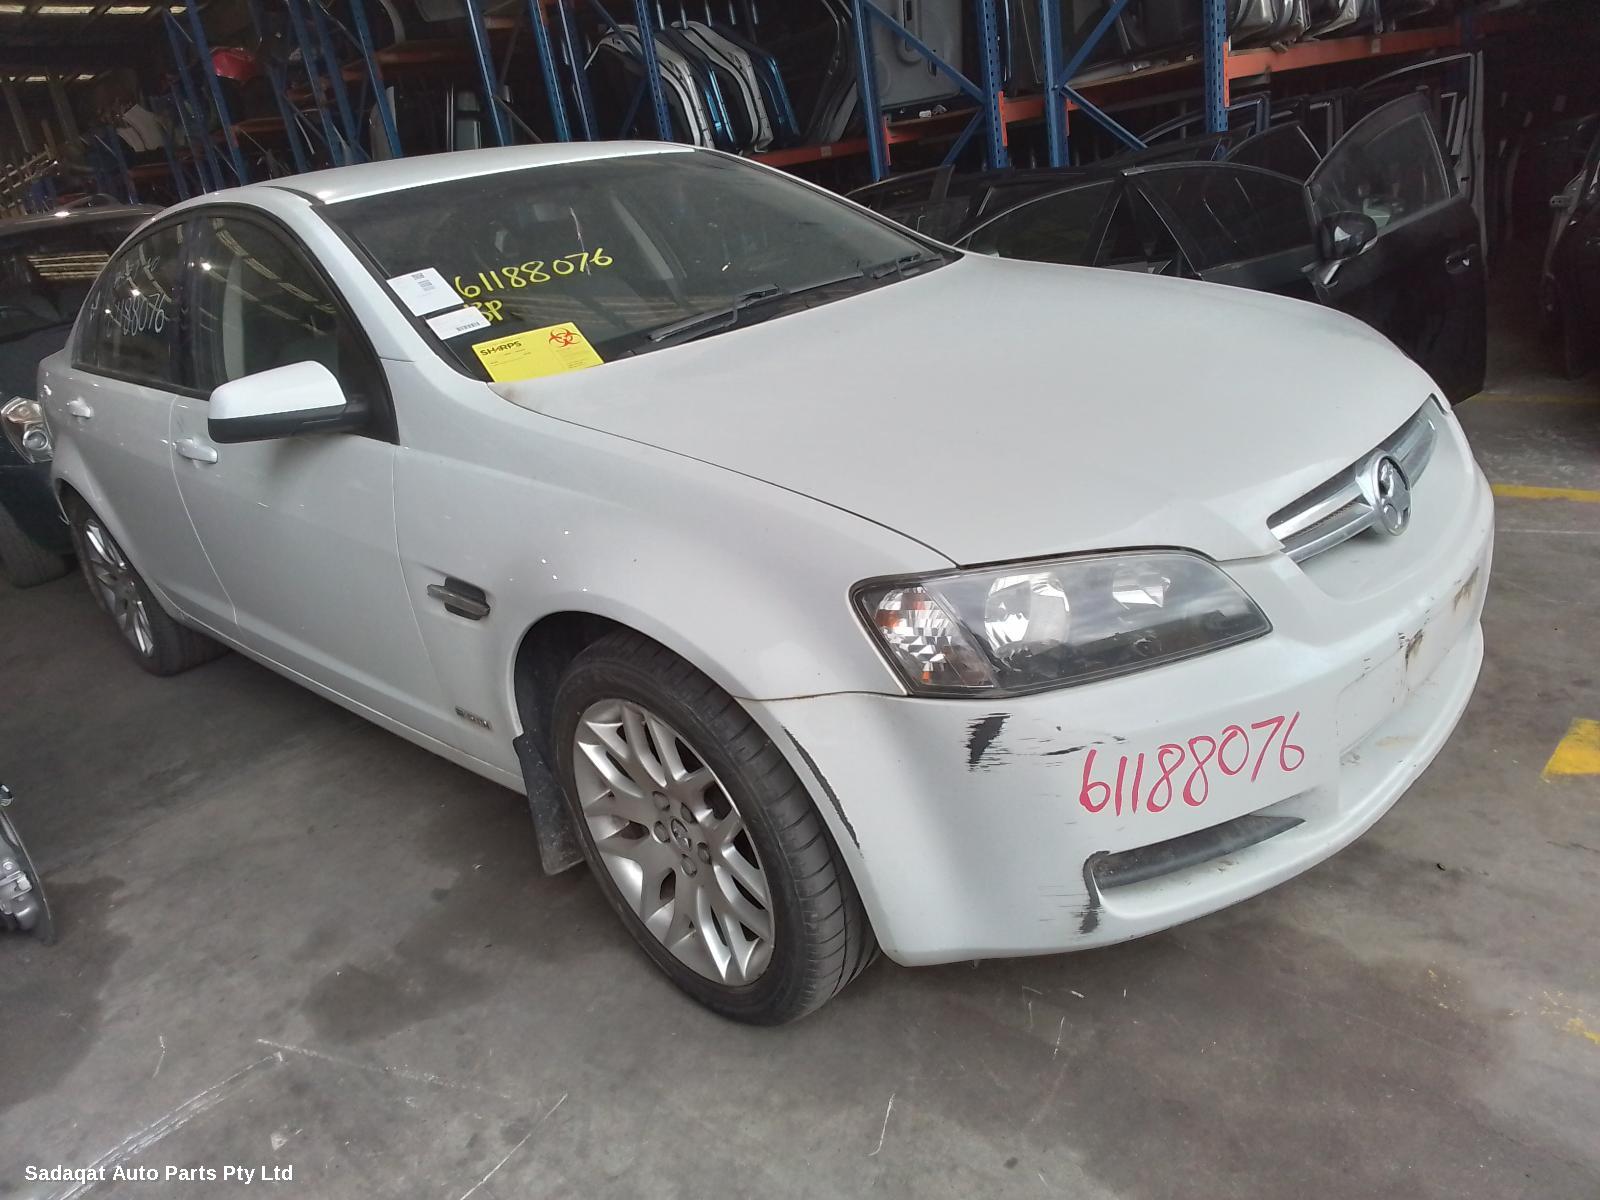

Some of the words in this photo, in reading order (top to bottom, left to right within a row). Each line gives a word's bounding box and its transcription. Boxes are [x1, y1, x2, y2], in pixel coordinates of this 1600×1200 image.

[455, 248, 613, 298] 61188076
[480, 340, 522, 357] SHARPS
[1079, 711, 1305, 816] 61188076
